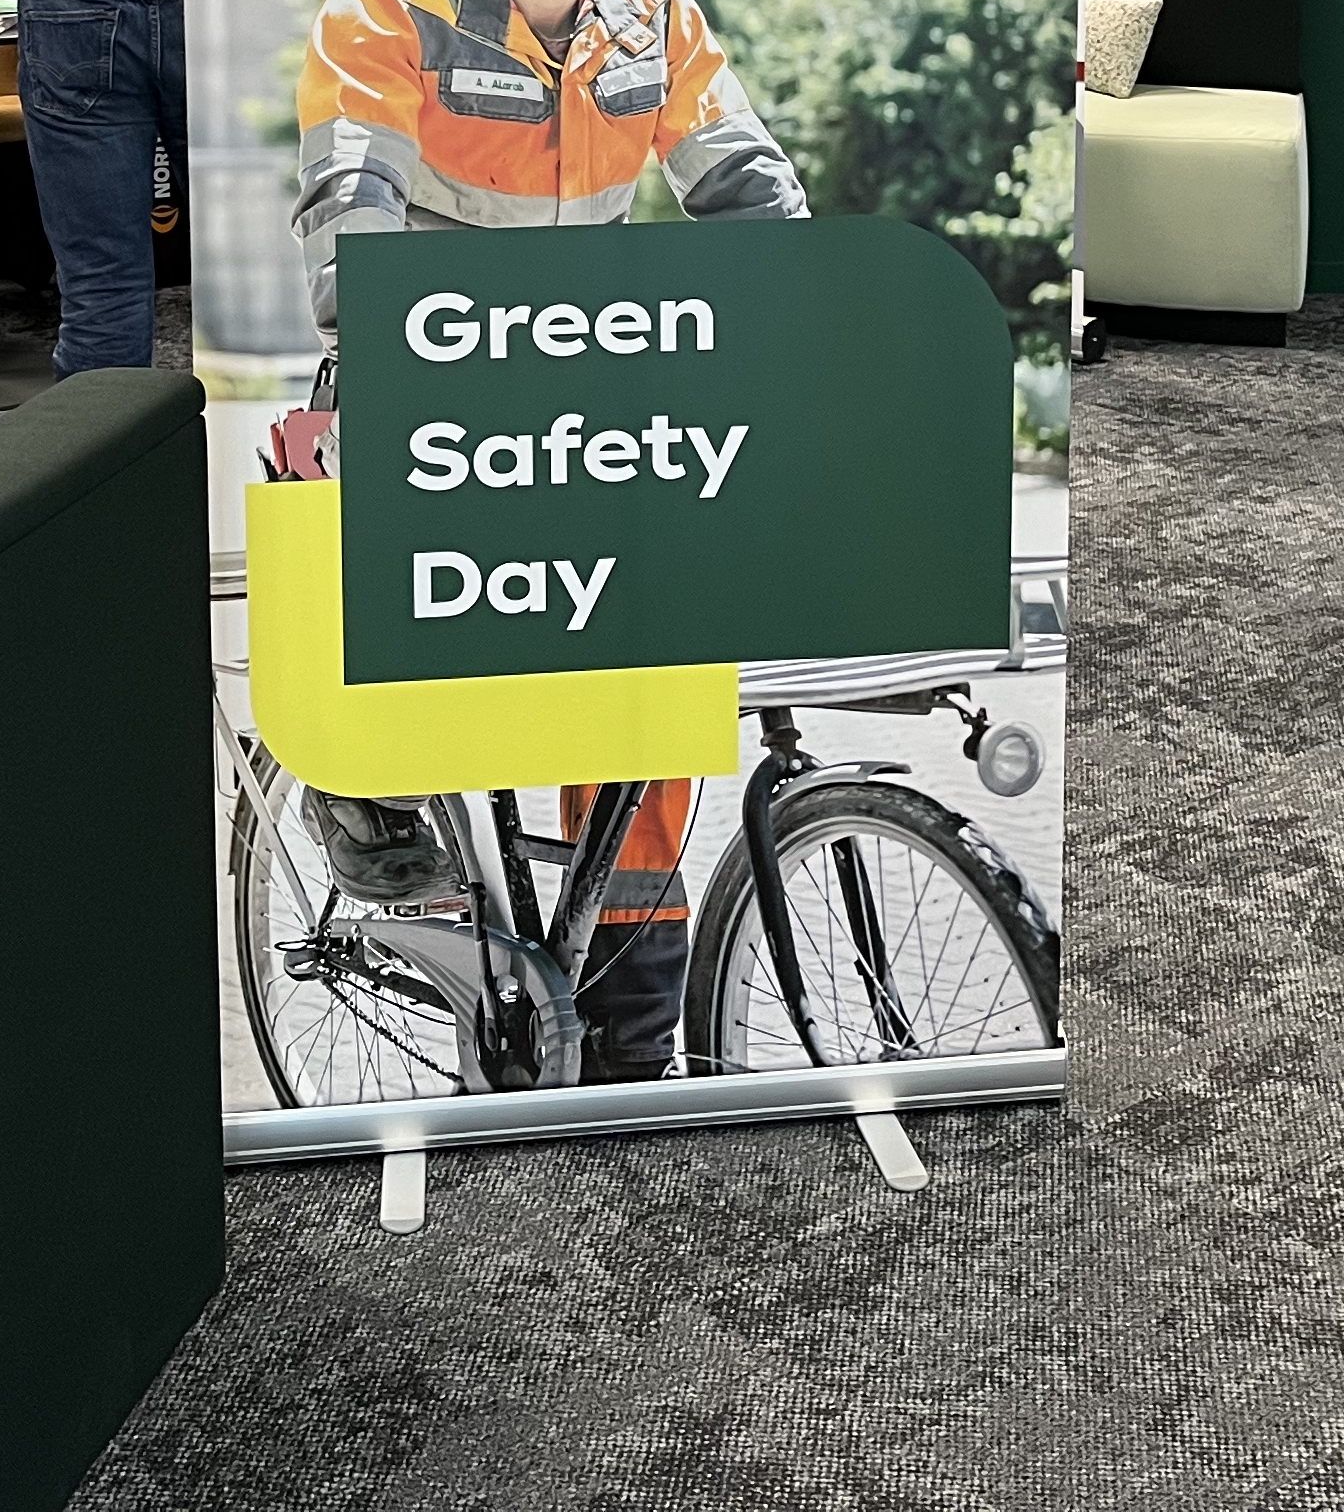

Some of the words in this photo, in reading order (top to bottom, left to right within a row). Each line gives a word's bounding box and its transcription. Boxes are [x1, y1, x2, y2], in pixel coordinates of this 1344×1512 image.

[405, 291, 715, 363] Green
[406, 412, 751, 500] Safety
[412, 550, 618, 632] Day
